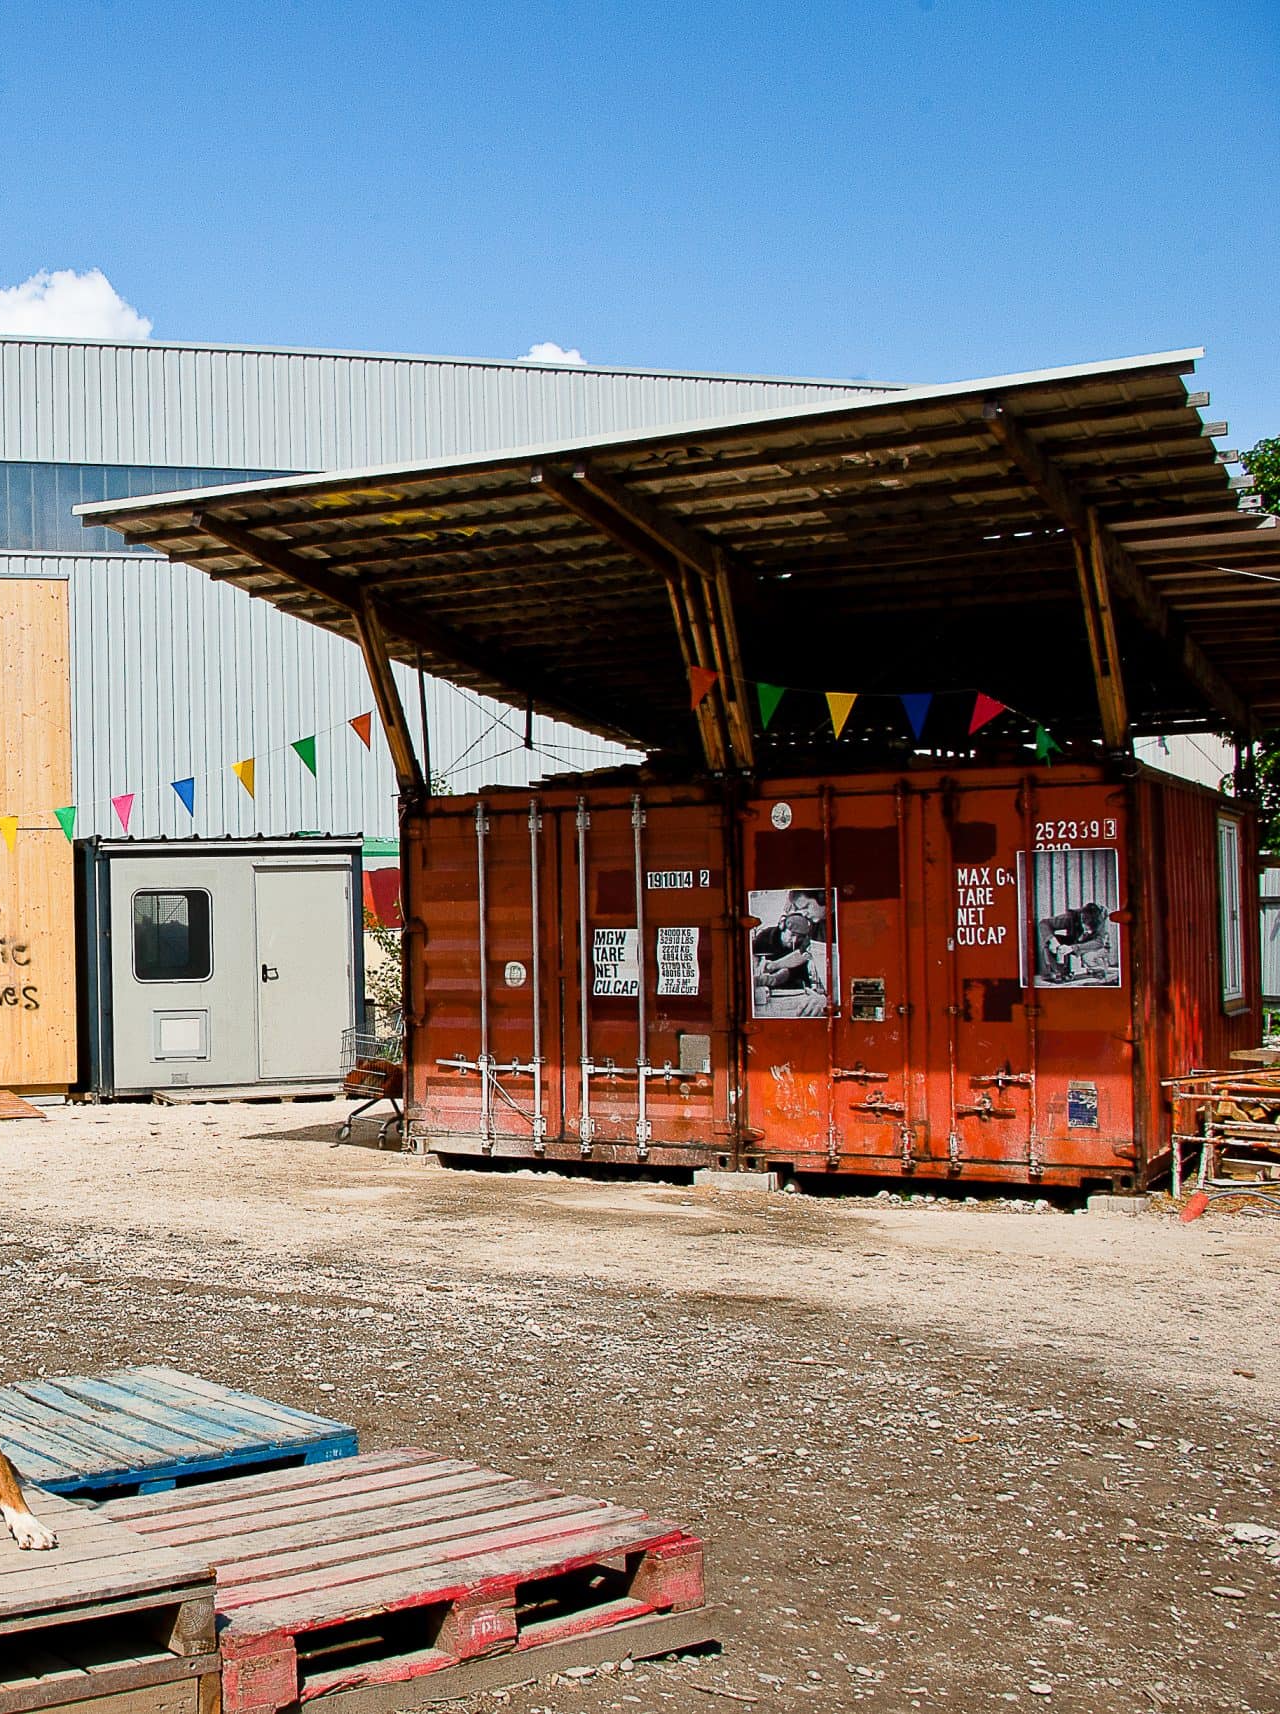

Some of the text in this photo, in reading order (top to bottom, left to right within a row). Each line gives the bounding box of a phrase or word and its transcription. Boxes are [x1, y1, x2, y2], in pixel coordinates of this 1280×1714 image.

[648, 871, 709, 888] 191014 2
[957, 867, 991, 886] MAX
[957, 887, 995, 906] TARE
[957, 907, 985, 926] NET
[595, 931, 627, 946] MGW
[681, 929, 692, 937] KG
[595, 947, 625, 962] TARE
[680, 945, 690, 953] KG
[680, 953, 693, 961] LBS
[596, 964, 619, 978] NET
[682, 969, 695, 977] LBS
[594, 980, 639, 995] CU.CAP
